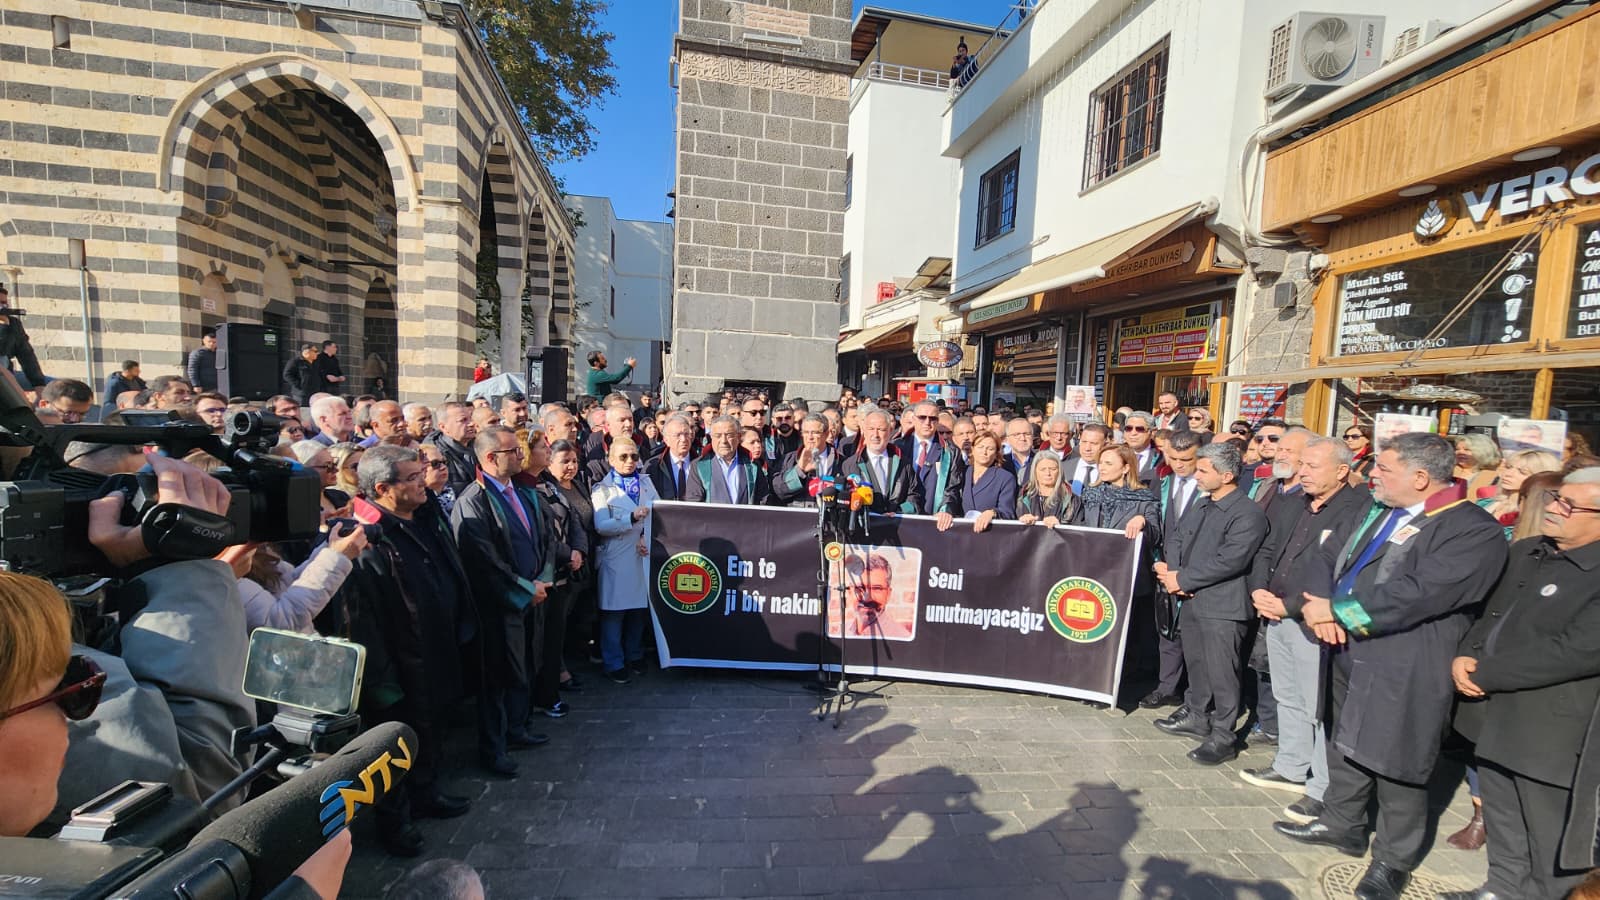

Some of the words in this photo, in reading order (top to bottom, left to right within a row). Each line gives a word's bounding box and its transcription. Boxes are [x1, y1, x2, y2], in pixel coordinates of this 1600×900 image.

[1346, 276, 1380, 289] Muzlu
[1382, 271, 1405, 283] Süt
[1393, 282, 1409, 292] Süt
[1343, 310, 1364, 323] ATOM
[1365, 306, 1393, 320] MUZLU
[1394, 302, 1412, 317] SÜT
[192, 526, 225, 540] SONY
[728, 555, 753, 577] Em
[759, 558, 777, 579] te
[928, 566, 964, 591] Seni
[724, 589, 737, 616] ji
[742, 590, 766, 613] bîr
[925, 603, 1045, 635] unutmayacağız
[338, 736, 411, 825] NTV
